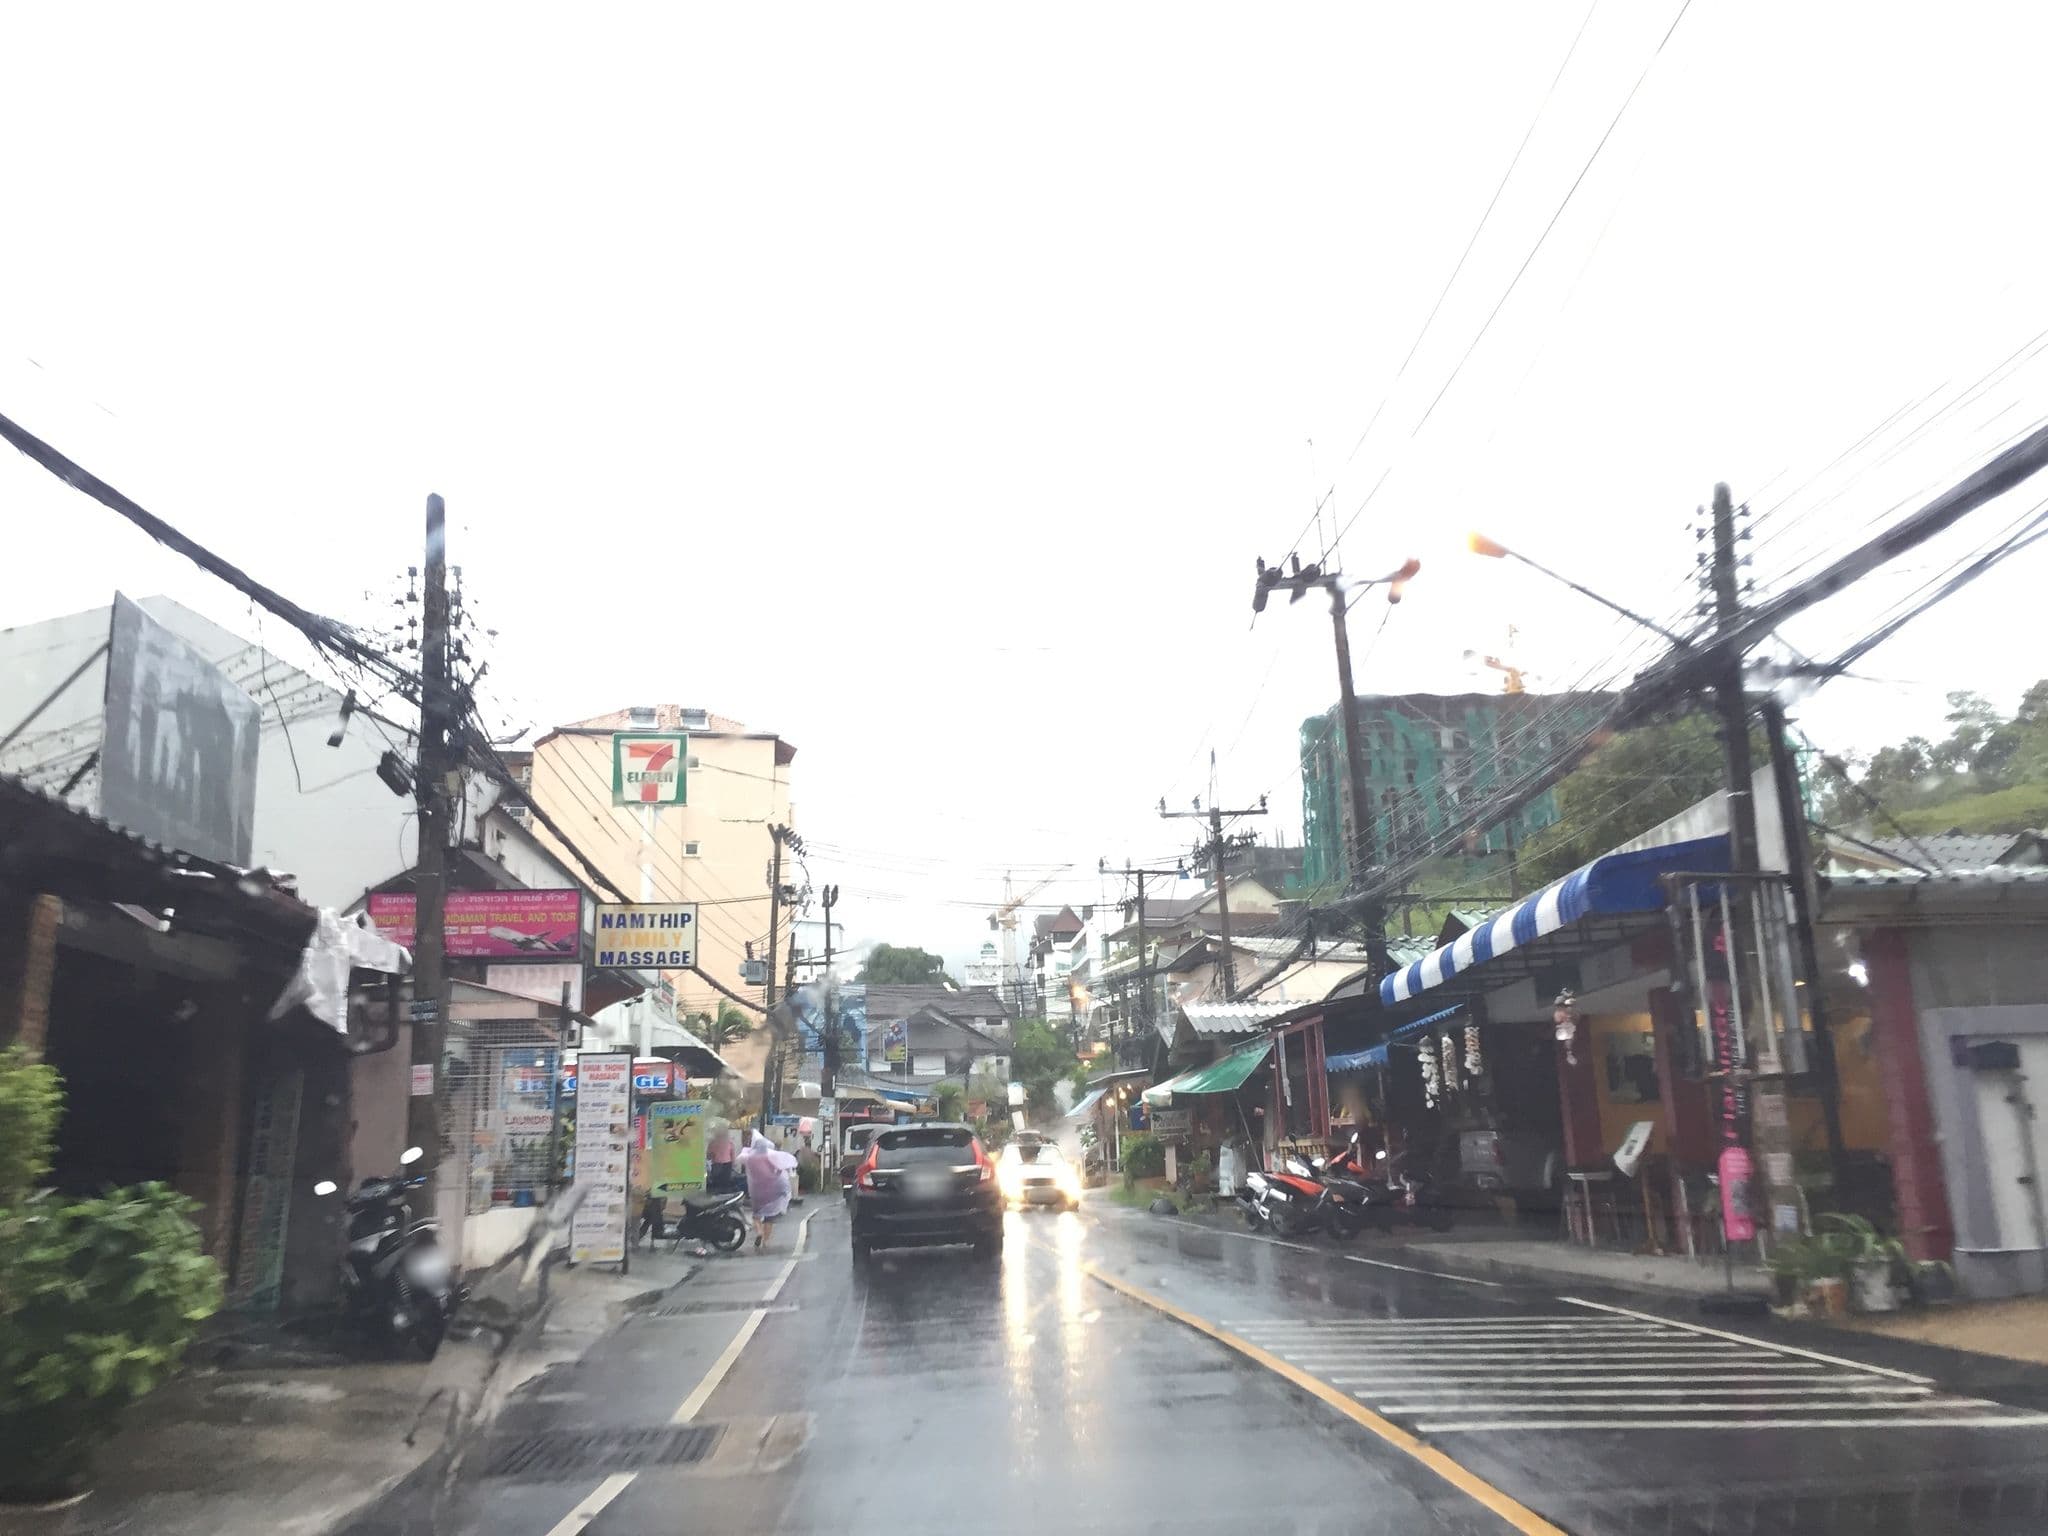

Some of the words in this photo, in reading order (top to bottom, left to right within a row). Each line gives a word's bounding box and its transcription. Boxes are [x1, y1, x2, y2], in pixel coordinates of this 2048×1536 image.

[629, 743, 674, 801] 7
[444, 912, 486, 924] NDAMAN
[490, 912, 524, 922] TRAVEL
[528, 912, 547, 922] AND
[551, 911, 576, 921] TOUR
[601, 913, 692, 928] NAMTHIP
[600, 951, 691, 965] MASSAGE
